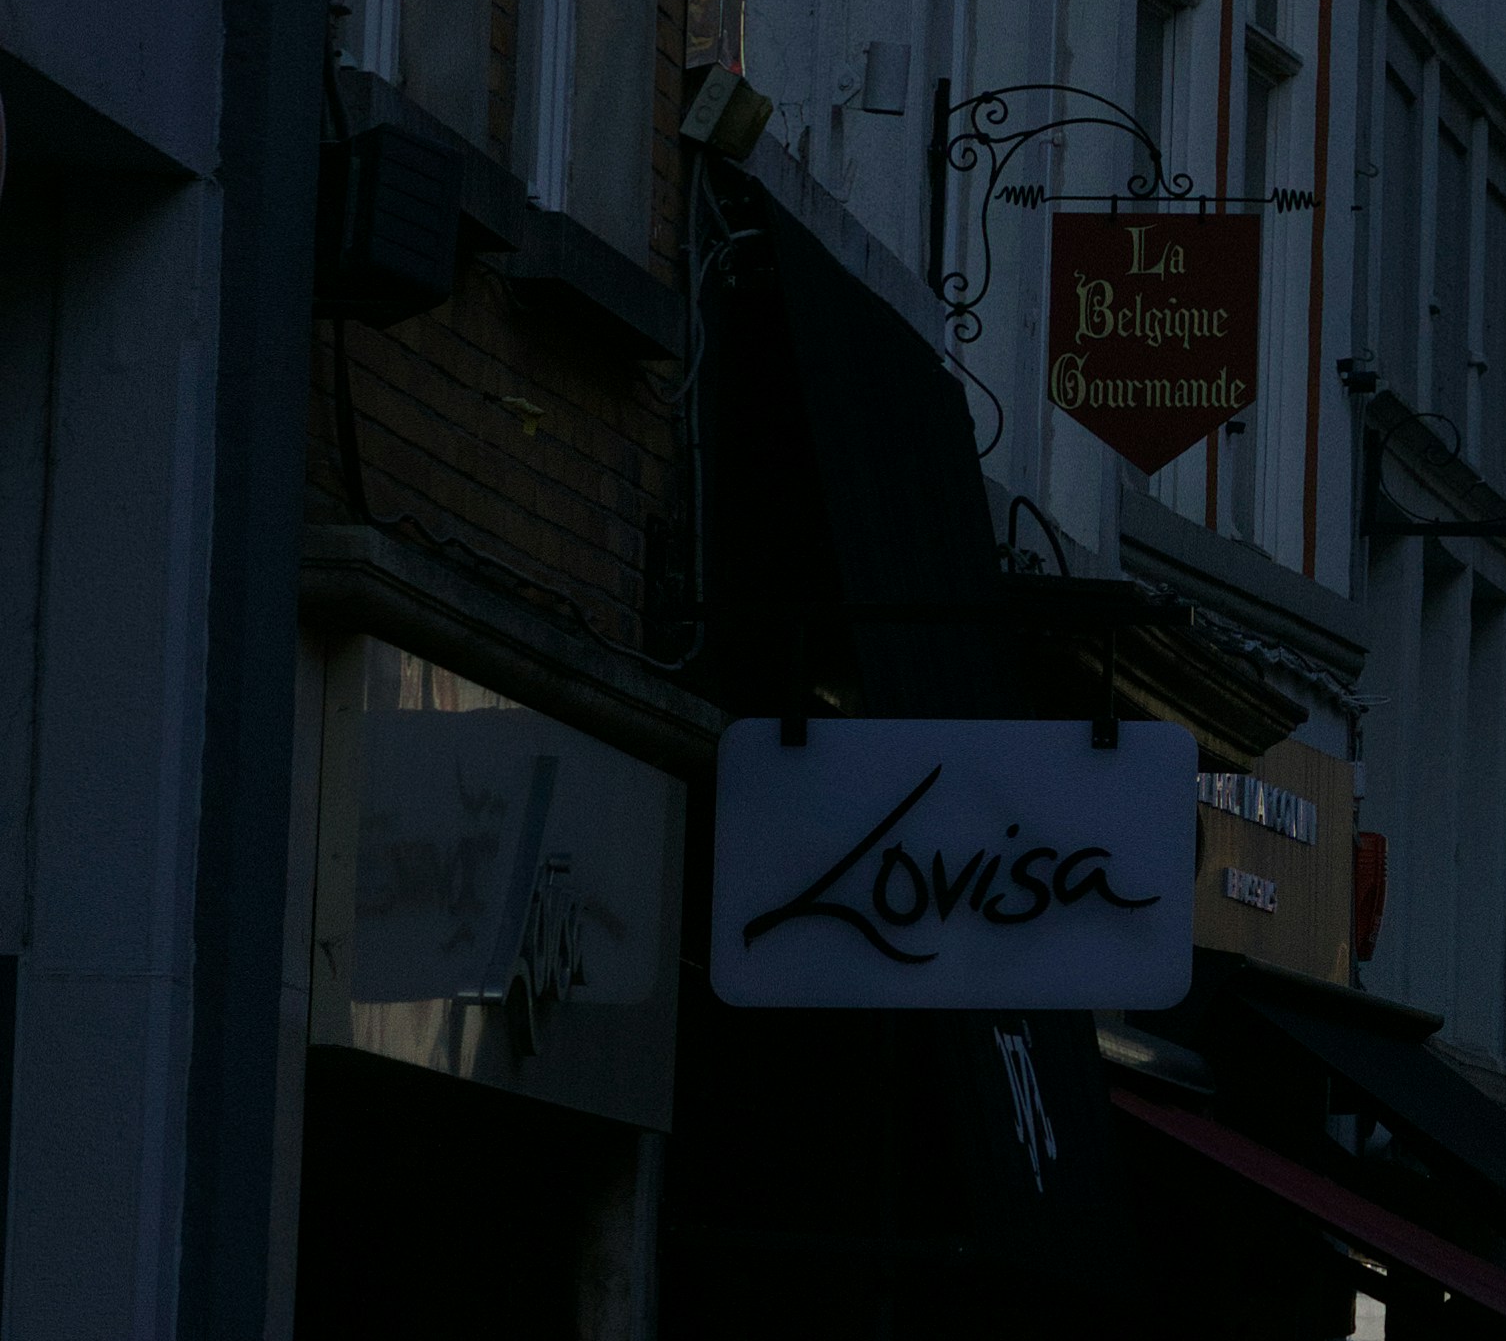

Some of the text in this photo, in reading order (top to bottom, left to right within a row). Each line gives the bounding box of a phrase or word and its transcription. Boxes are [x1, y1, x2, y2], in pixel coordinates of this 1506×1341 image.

[1124, 223, 1186, 282] La
[1073, 269, 1229, 350] Belgique
[1051, 351, 1247, 410] Gourmande
[743, 763, 1162, 965] Lovisa
